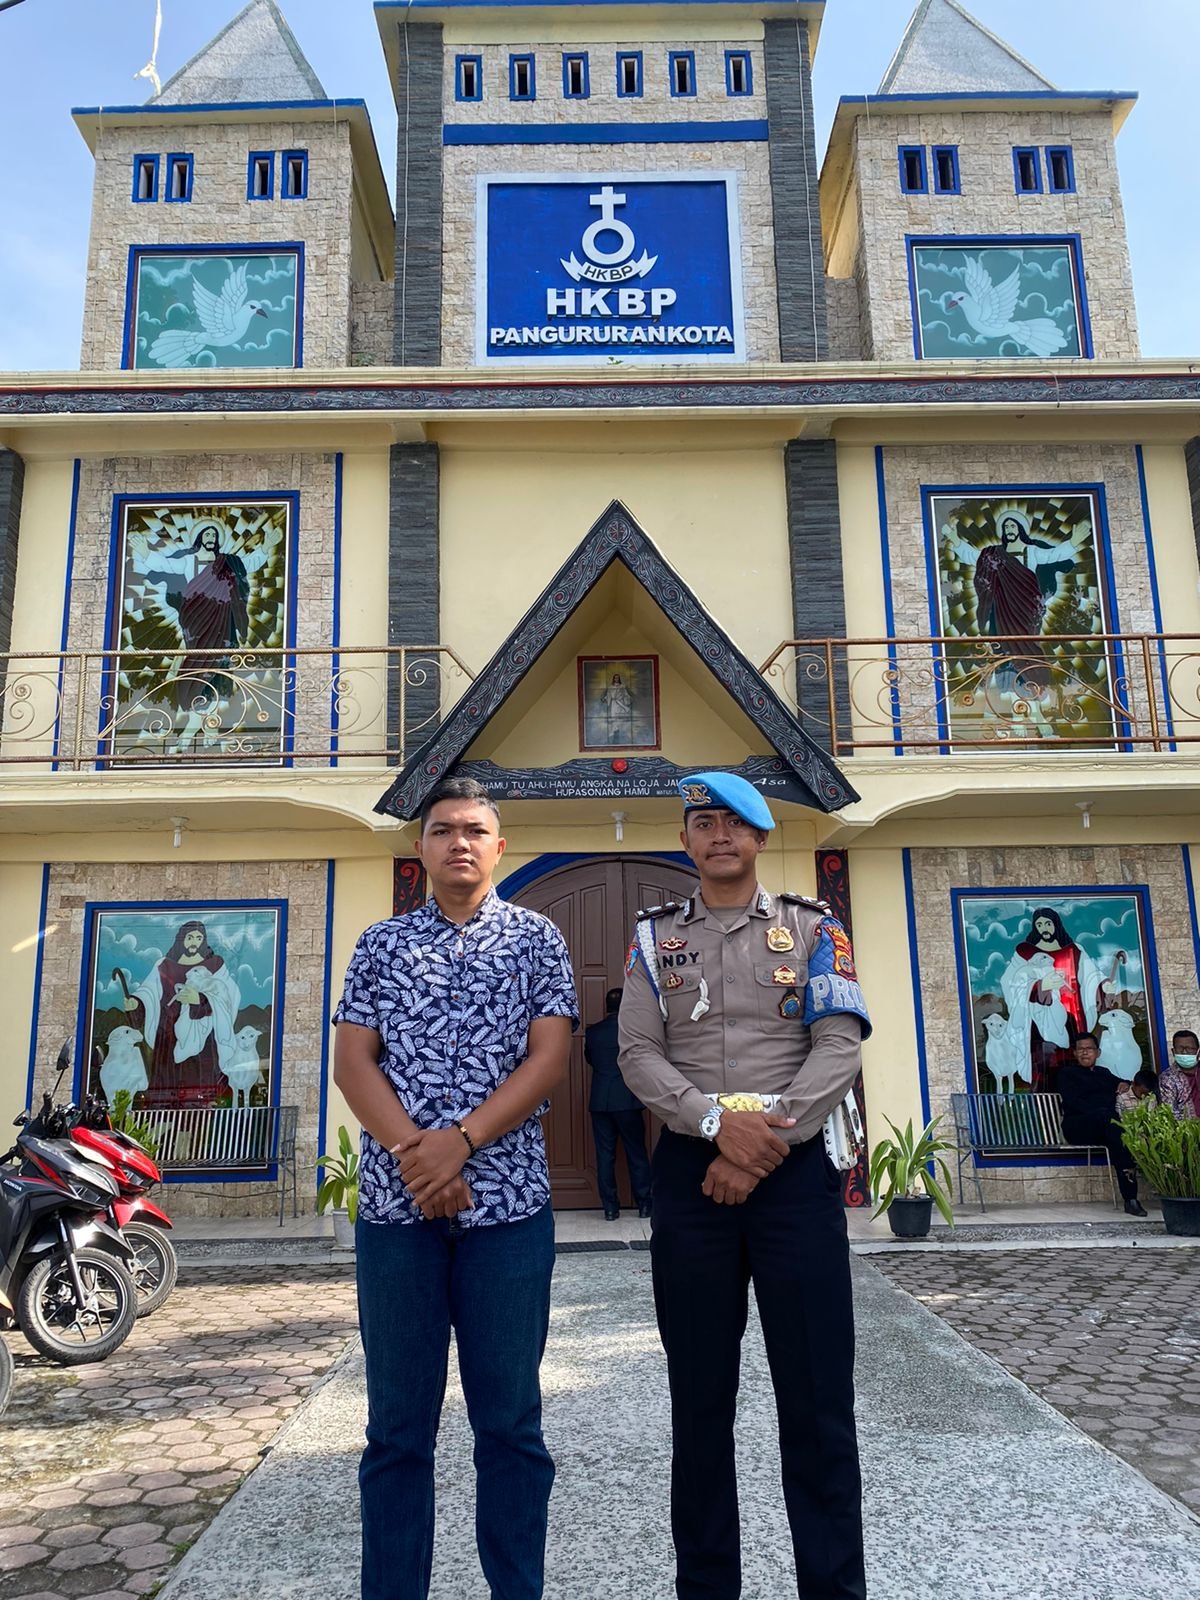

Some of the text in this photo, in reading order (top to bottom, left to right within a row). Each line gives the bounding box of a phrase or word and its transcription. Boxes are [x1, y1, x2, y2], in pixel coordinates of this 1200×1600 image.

[583, 264, 634, 281] HKBP
[546, 287, 677, 316] HKBP
[511, 781, 526, 789] TU
[549, 780, 577, 788] HAMU
[580, 779, 614, 788] ANGKA
[616, 779, 631, 788] NA
[633, 779, 660, 788] LOJA
[752, 777, 787, 786] Asa
[555, 787, 621, 797] HUPASONANG
[624, 787, 650, 796] HAMU
